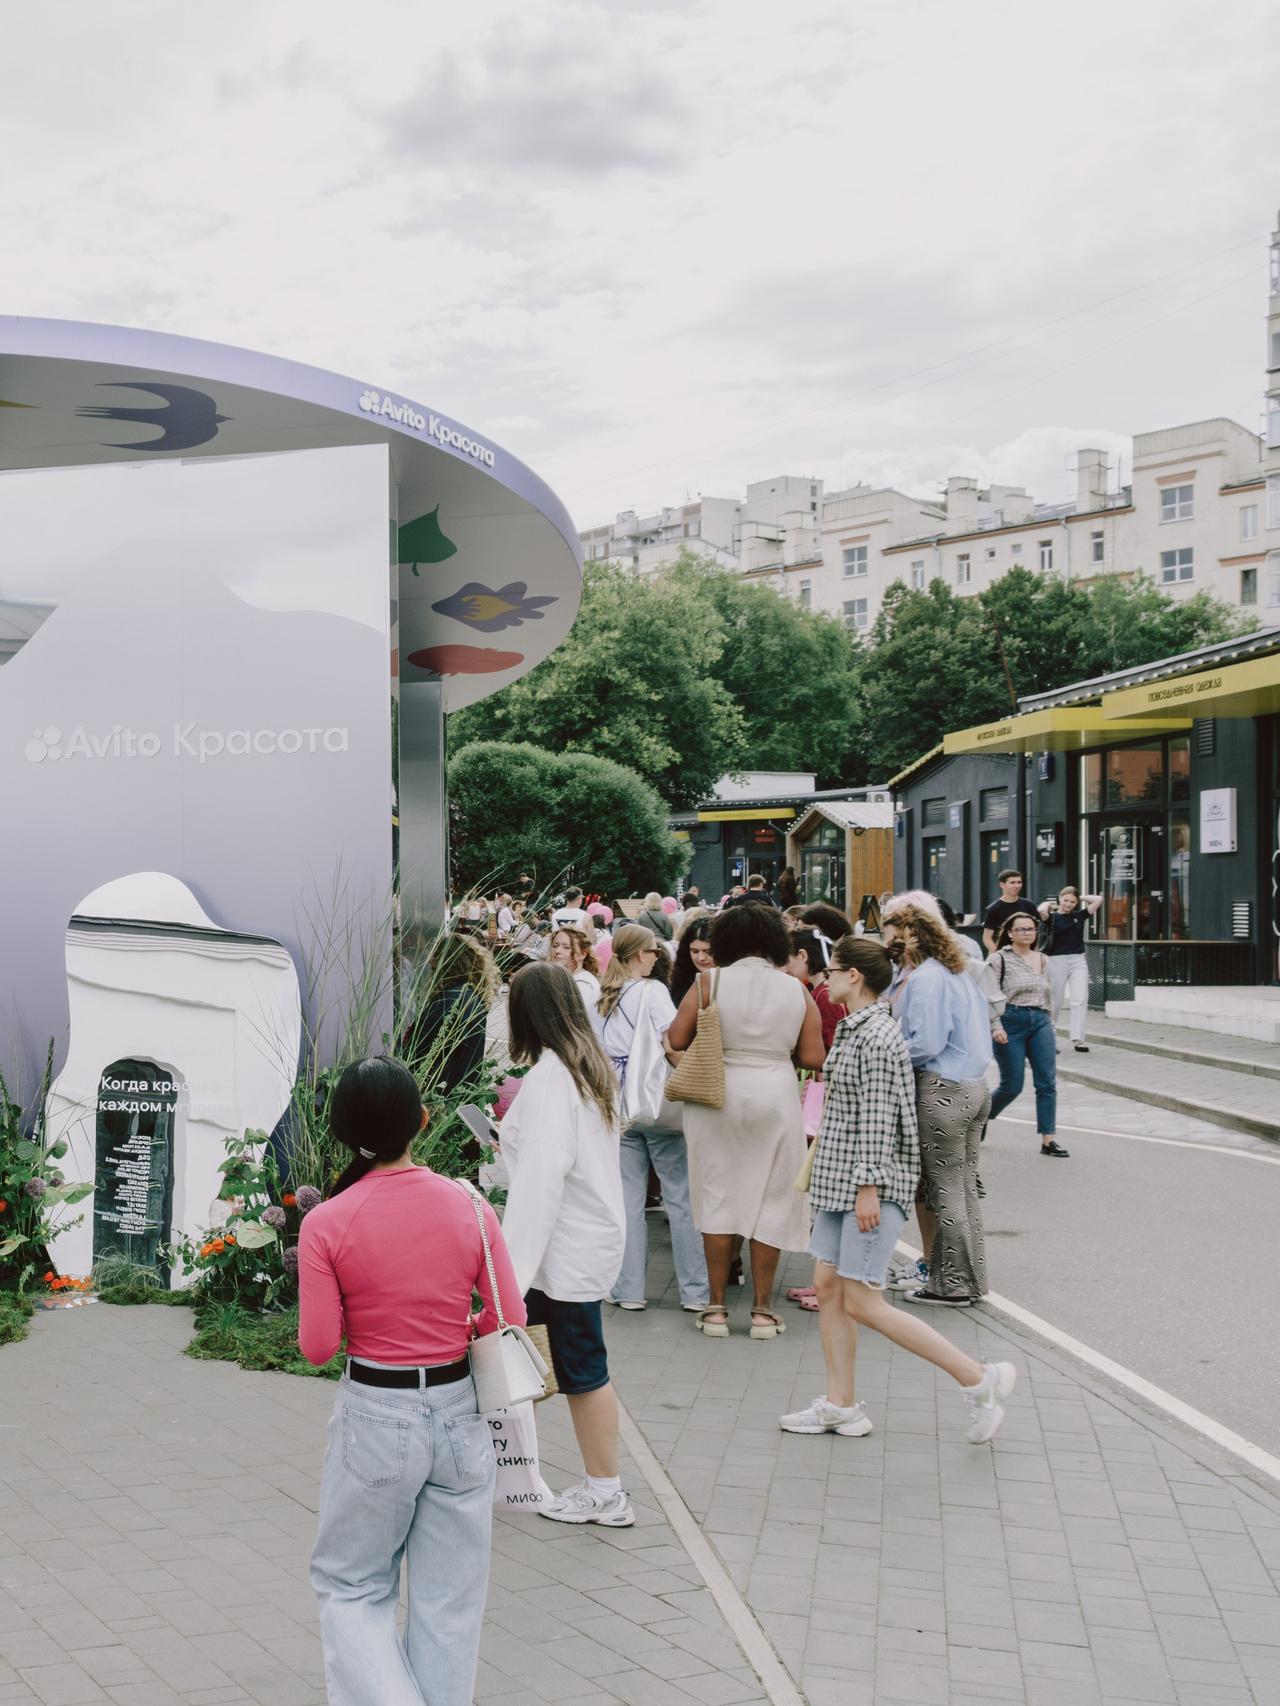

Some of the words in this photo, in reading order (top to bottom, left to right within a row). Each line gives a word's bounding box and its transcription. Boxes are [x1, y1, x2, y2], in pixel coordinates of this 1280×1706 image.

[379, 396, 426, 431] Avito
[428, 415, 495, 467] Красота
[64, 724, 162, 759] Avito
[174, 722, 349, 764] Красота
[101, 1076, 149, 1092] Когда
[99, 1099, 162, 1113] каждом
